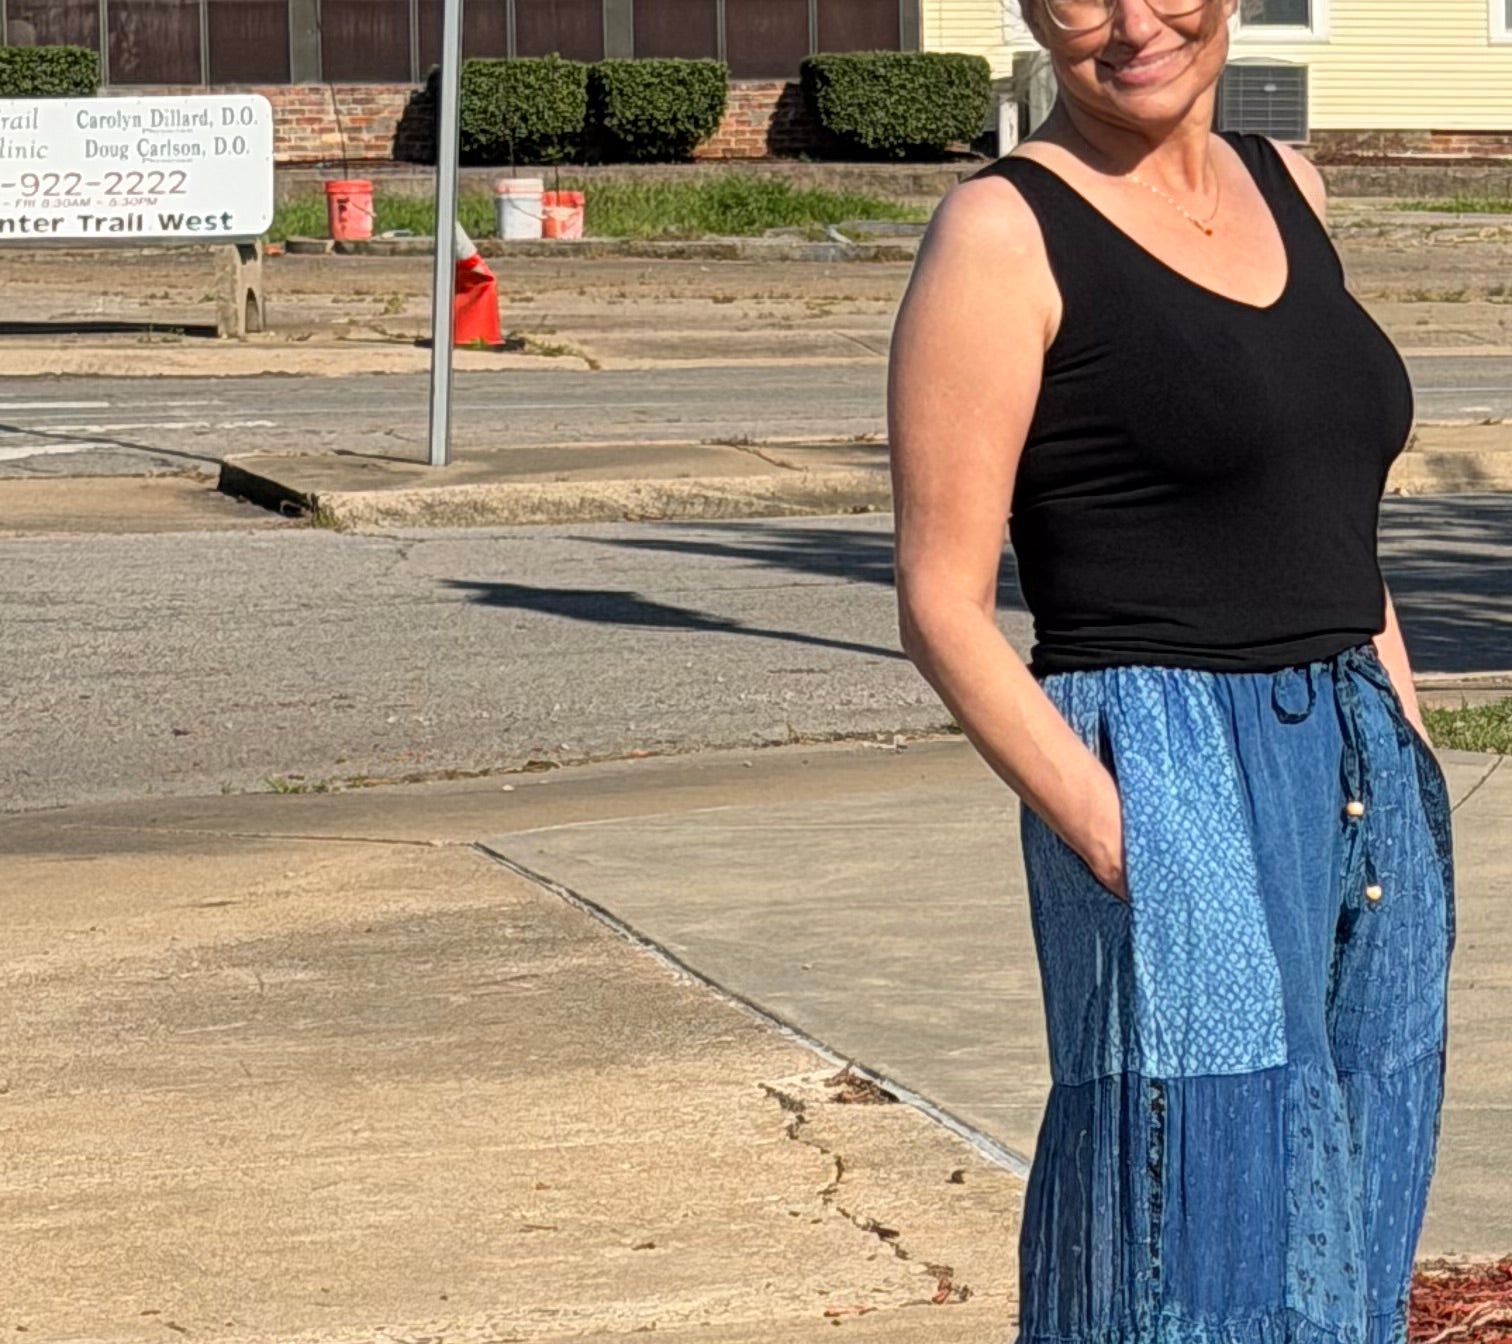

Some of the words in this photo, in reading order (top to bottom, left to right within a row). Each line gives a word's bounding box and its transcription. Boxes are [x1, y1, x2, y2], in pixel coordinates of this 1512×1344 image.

[0, 107, 39, 131] rail
[76, 109, 142, 131] Carolyn
[150, 107, 214, 128] Dillard,
[221, 106, 258, 126] D.O.
[85, 139, 129, 161] Doug
[136, 138, 206, 158] Carlson,
[213, 135, 251, 156] D.O.
[77, 212, 143, 232] Trail
[159, 211, 233, 231] West
